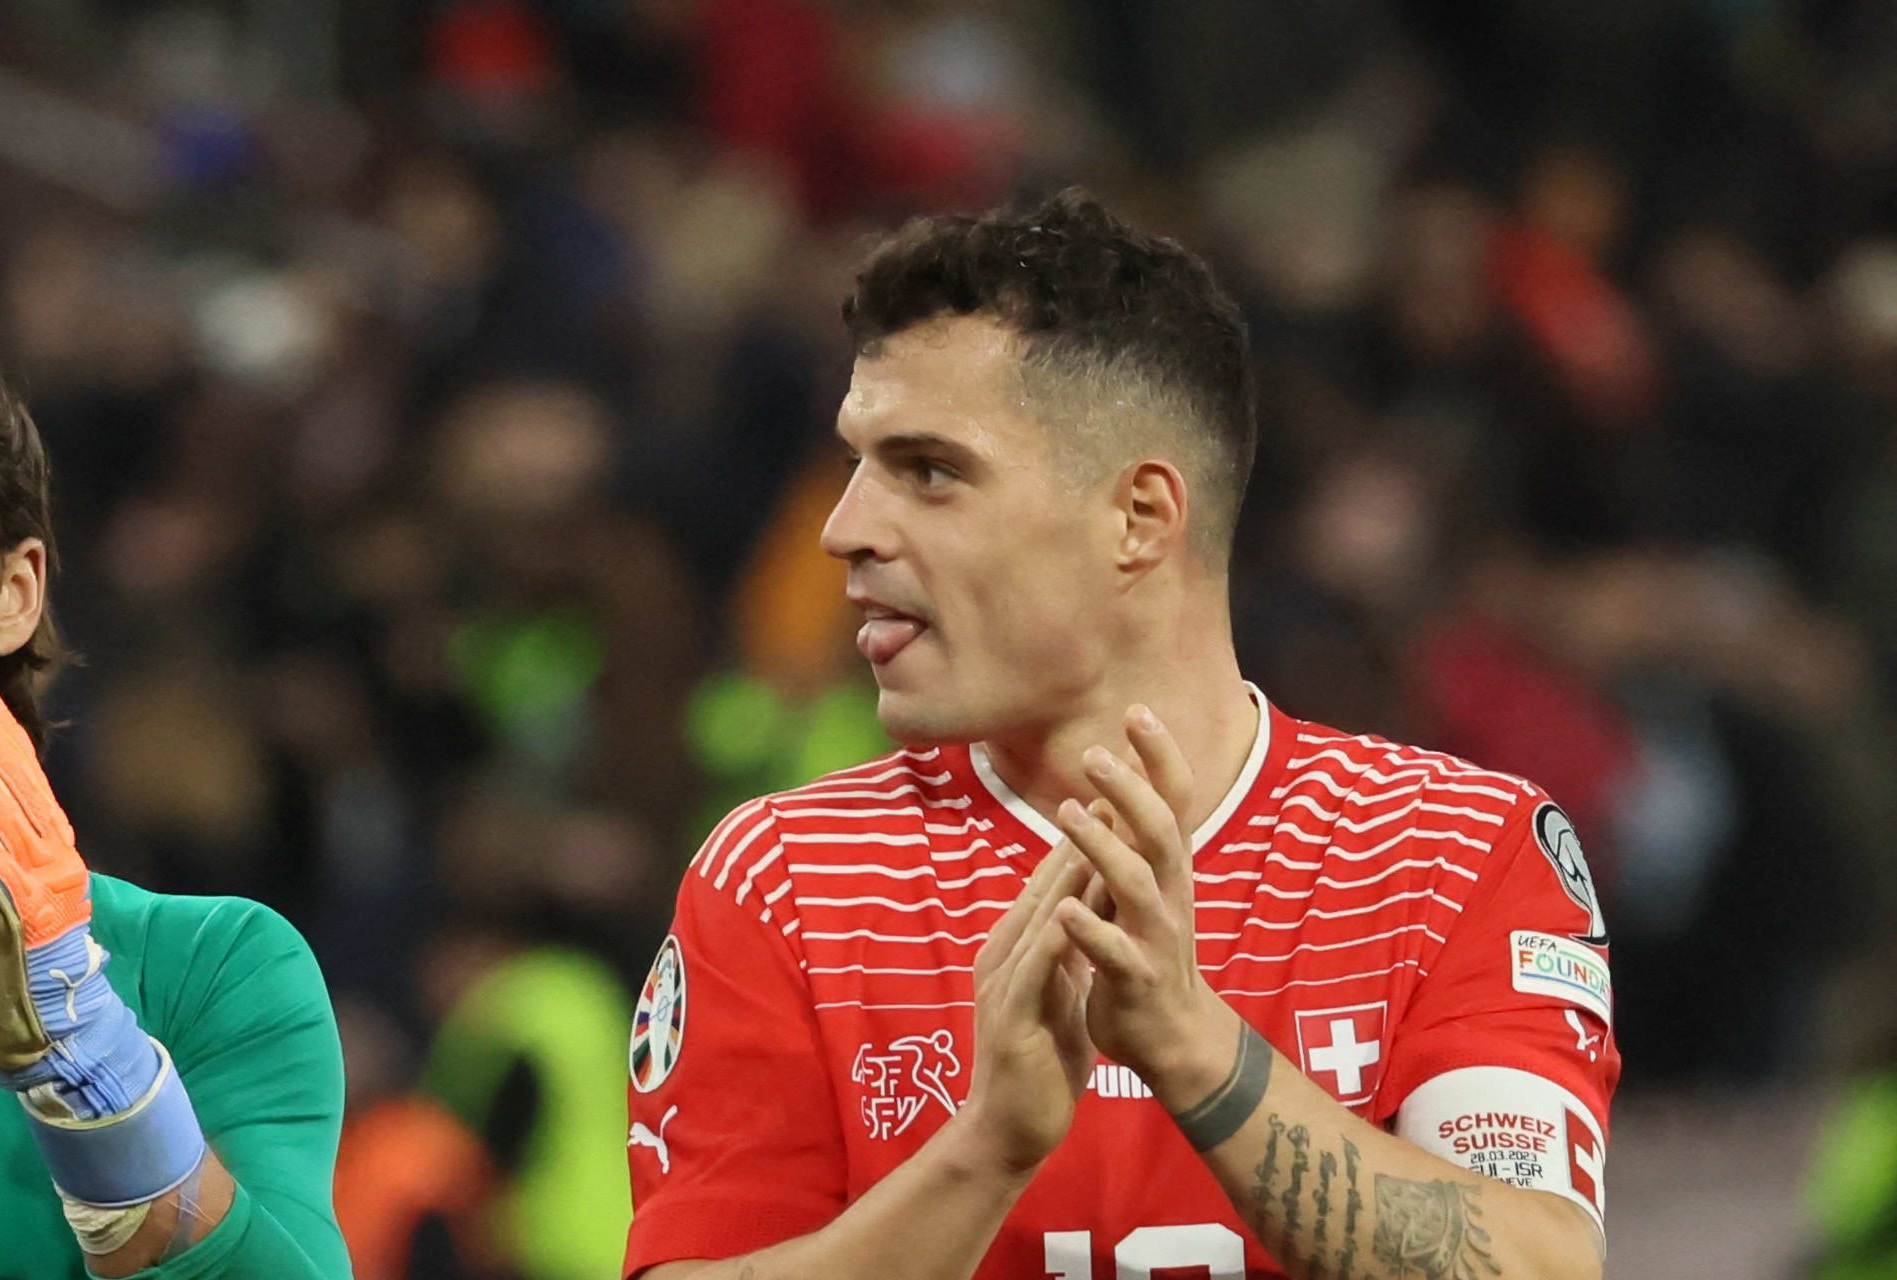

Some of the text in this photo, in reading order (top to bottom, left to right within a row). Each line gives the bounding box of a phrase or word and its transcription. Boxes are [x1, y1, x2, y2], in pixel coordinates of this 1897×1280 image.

[1517, 935, 1558, 953] UEFA
[1518, 950, 1611, 999] FOUNDA
[1086, 1064, 1154, 1099] UM
[1438, 1112, 1558, 1140] SCHWEIZ
[1453, 1132, 1548, 1155] SUISSE
[1470, 1150, 1538, 1164] 28.03.2023
[1515, 1161, 1543, 1179] ISR
